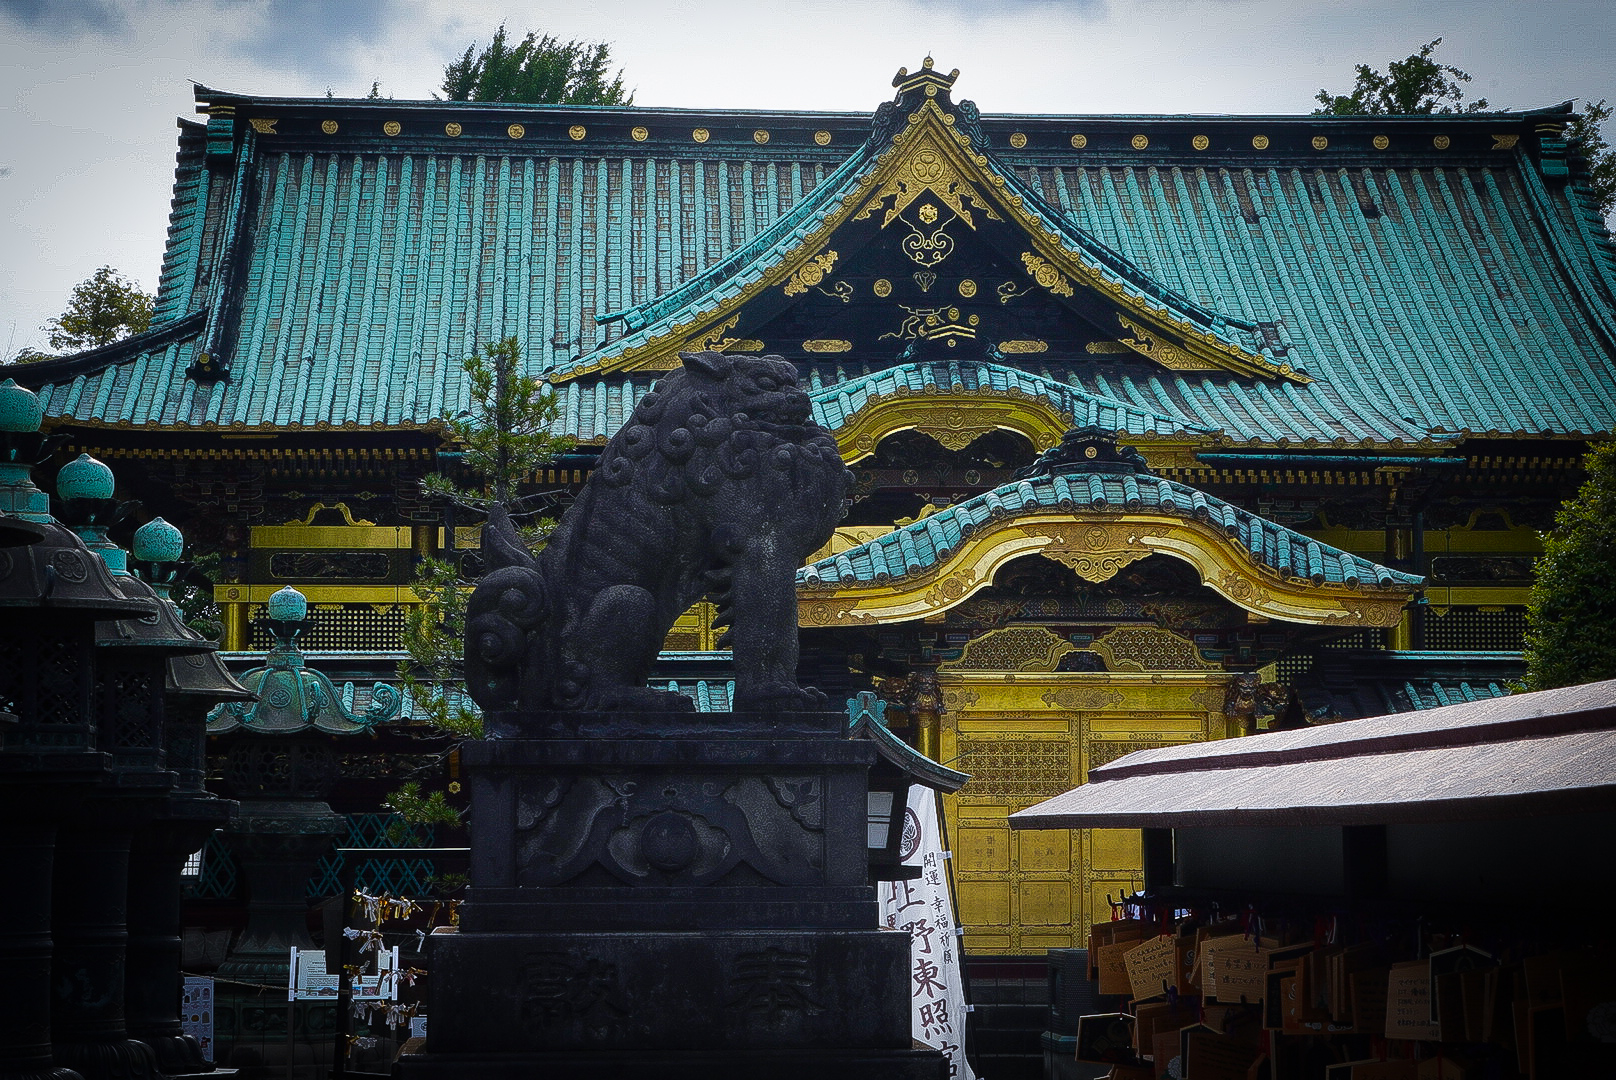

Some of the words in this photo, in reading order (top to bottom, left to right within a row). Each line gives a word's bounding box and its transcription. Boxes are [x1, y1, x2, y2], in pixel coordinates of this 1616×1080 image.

[897, 880, 960, 1078] 上野東照宮
